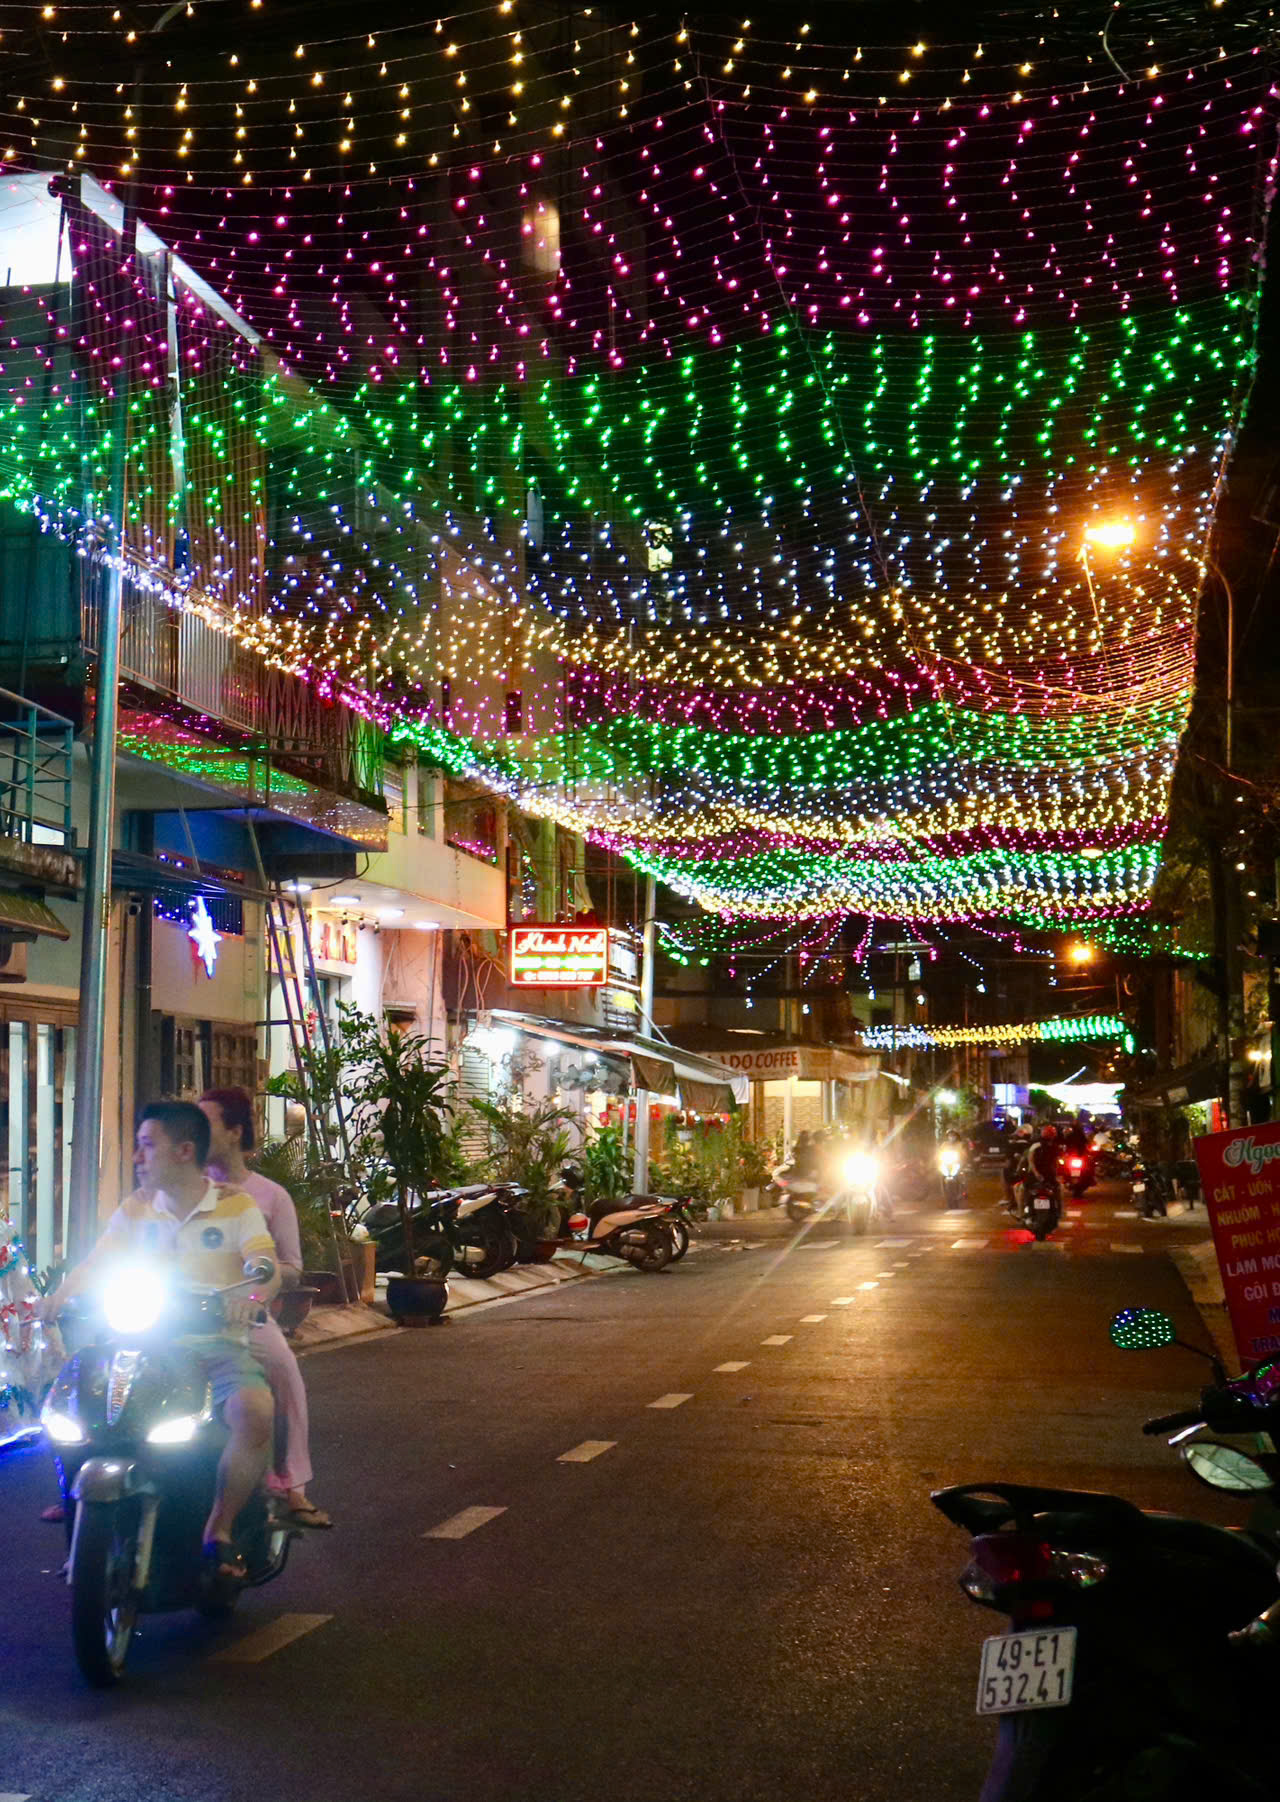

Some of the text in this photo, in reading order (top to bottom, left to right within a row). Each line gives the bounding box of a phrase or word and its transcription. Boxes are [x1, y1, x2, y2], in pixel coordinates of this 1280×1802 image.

[755, 1051, 798, 1068] COFFEE
[997, 1633, 1060, 1672] 49-E1
[984, 1668, 1065, 1708] 532.41
